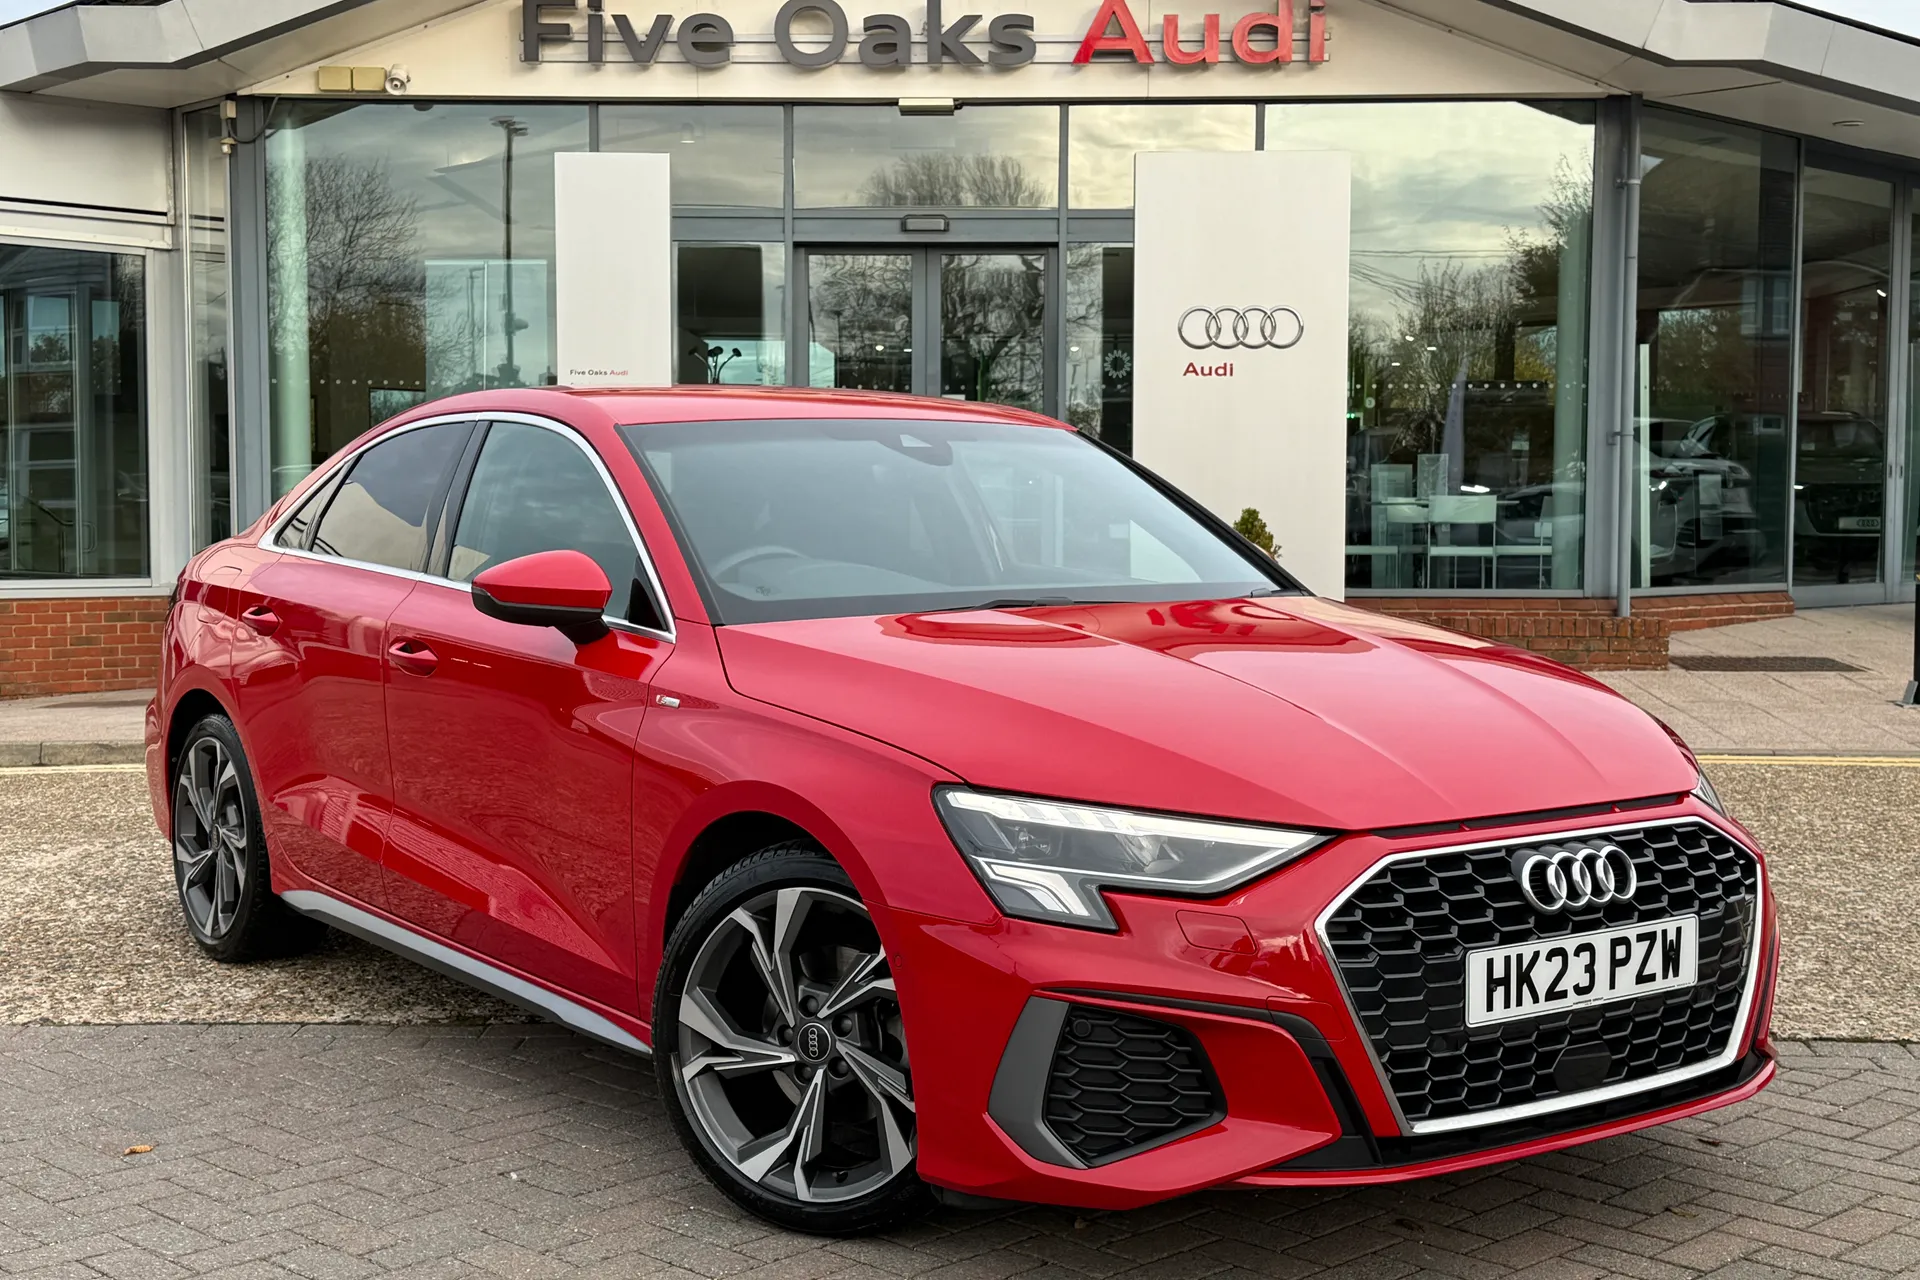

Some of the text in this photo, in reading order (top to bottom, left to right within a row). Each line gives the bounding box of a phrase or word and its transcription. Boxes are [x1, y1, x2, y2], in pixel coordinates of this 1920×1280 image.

[523, 0, 1327, 68] Five Oaks Audi
[1182, 362, 1234, 377] Audi
[1486, 926, 1682, 1013] HK23 PZW
